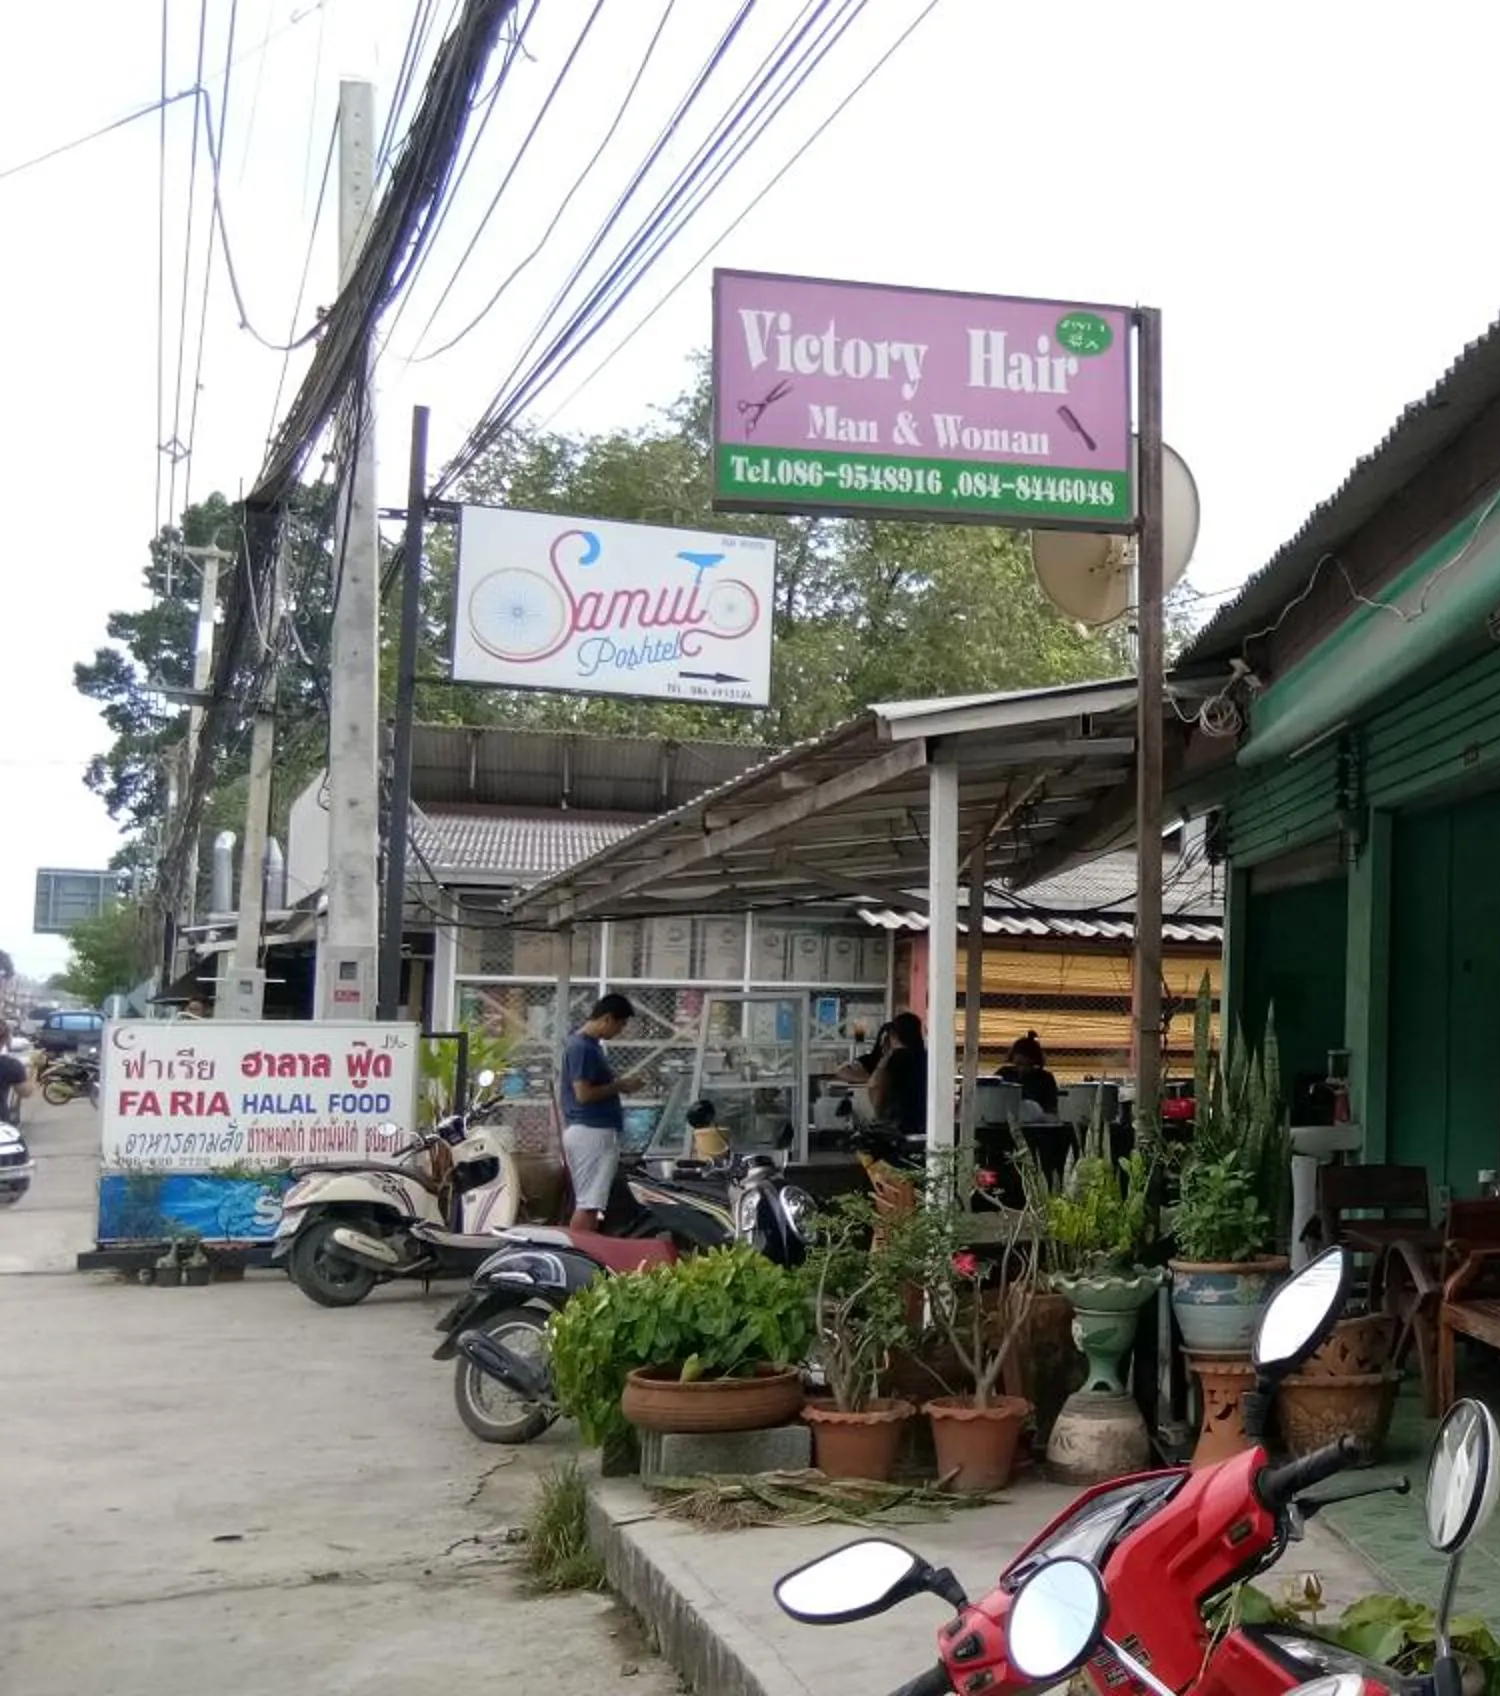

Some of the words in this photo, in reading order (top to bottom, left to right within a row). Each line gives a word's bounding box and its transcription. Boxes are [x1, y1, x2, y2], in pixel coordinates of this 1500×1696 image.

[738, 309, 928, 400] Victory
[966, 328, 1079, 395] Hair
[806, 403, 879, 443] Man
[892, 412, 923, 448] &
[932, 414, 1050, 456] Woman
[123, 1048, 217, 1081] ฟาเรีย
[241, 1052, 331, 1078] ฮาลาล
[242, 1094, 316, 1114] HALAL
[328, 1094, 391, 1114] FOOD
